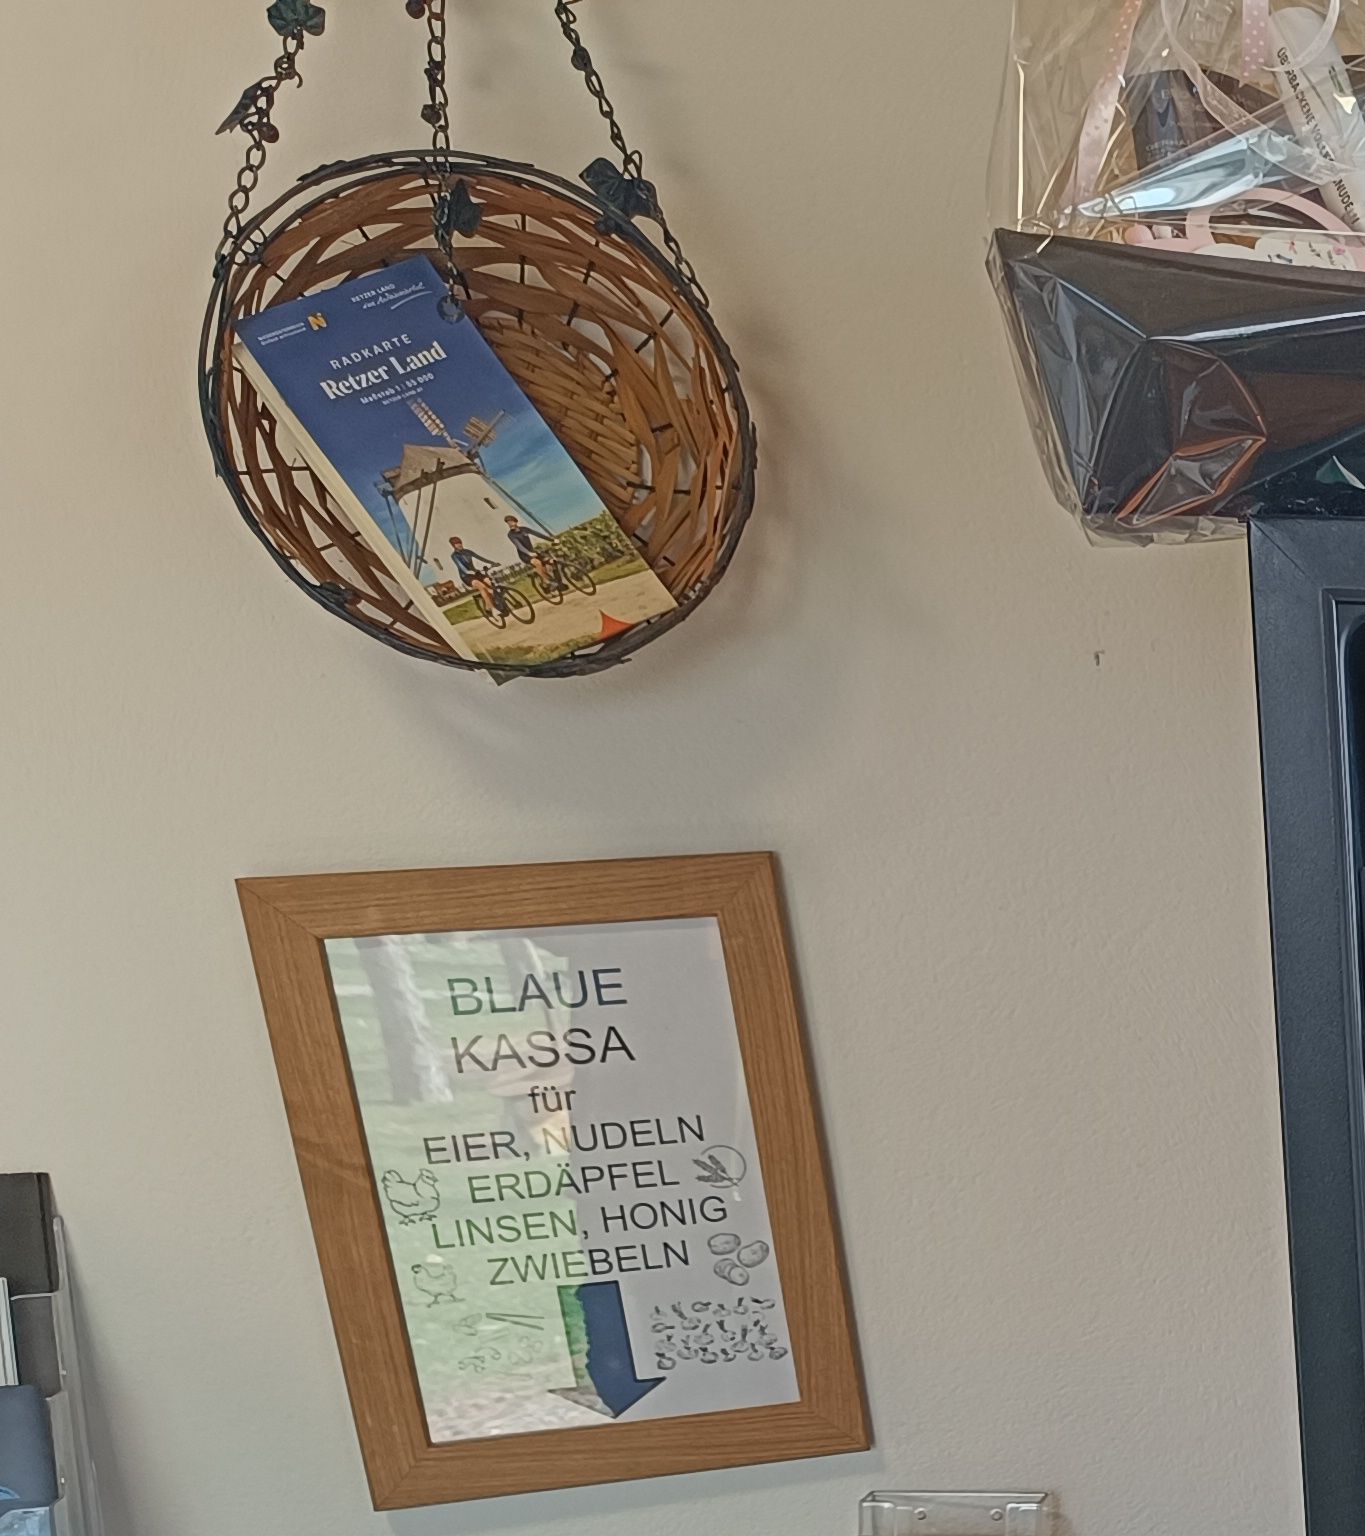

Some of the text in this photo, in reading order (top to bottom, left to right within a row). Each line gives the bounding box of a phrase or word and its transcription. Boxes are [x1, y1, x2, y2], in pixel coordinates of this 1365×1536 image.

[319, 340, 448, 400] Retzer Land
[329, 333, 412, 370] RADKARTE
[447, 967, 629, 1016] BLAUE
[450, 1025, 636, 1074] KASSA
[528, 1085, 577, 1114] für
[423, 1114, 705, 1166] EIER, NUDELN
[467, 1159, 680, 1205] ERDÄPFEL
[432, 1194, 729, 1250] LINSEN, HONIG
[488, 1239, 690, 1287] ZWIEBELN
